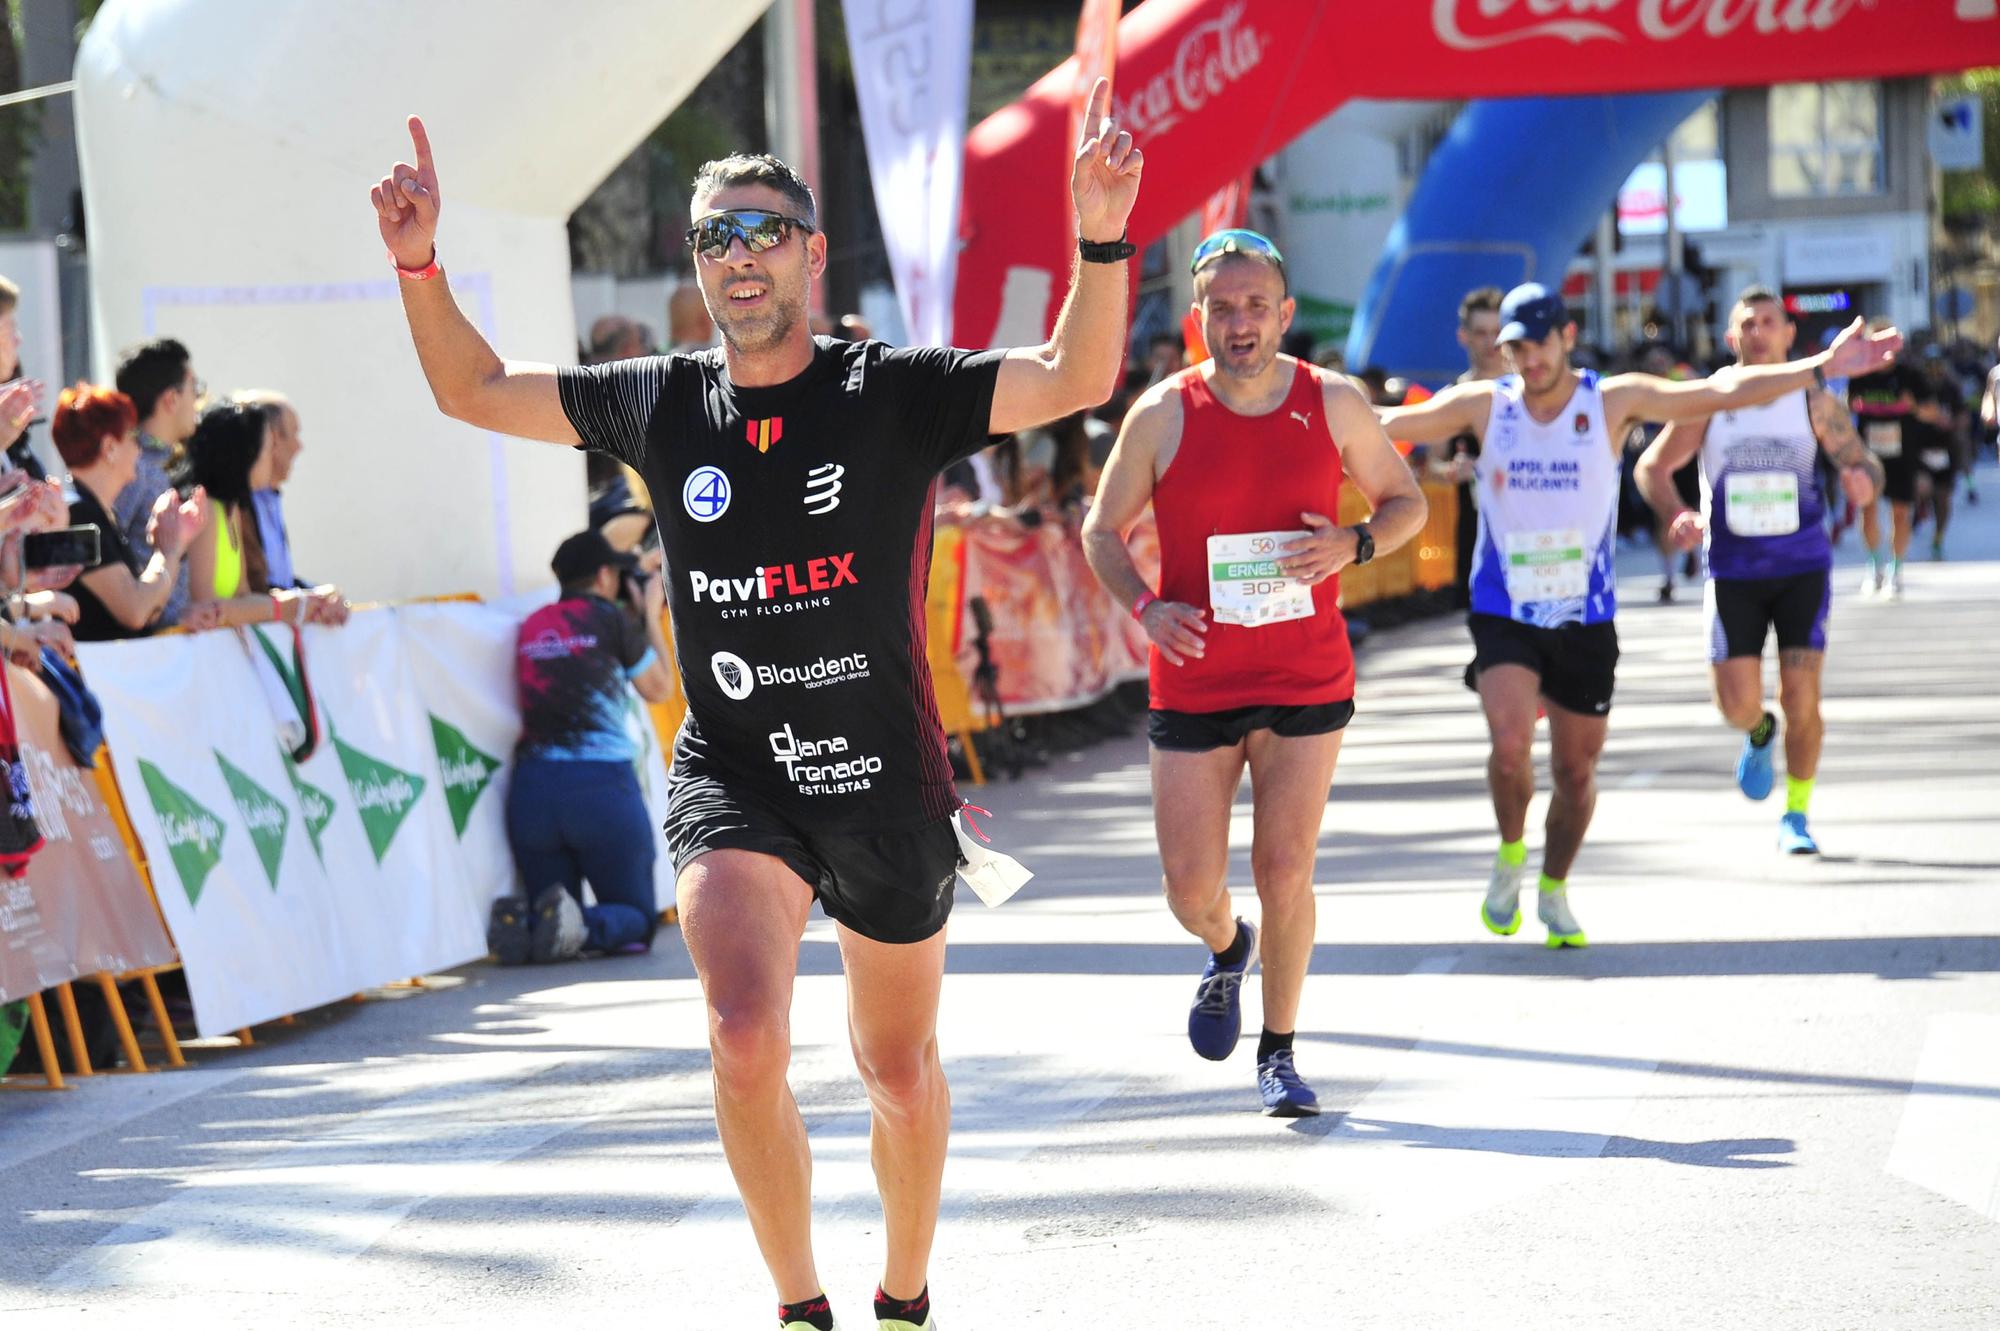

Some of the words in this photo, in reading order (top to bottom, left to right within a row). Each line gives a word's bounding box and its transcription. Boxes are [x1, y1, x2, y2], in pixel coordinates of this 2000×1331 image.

[691, 471, 727, 517] 4
[689, 552, 858, 603] PaviFLEX
[1227, 562, 1279, 577] ERNES
[1242, 581, 1286, 596] 302
[721, 608, 748, 619] GYM
[757, 596, 831, 616] FLOORING
[756, 653, 868, 685] Blaudent
[804, 675, 846, 689] laboratorio
[846, 669, 871, 680] dental
[774, 755, 882, 782] Trenado
[799, 778, 871, 796] ESTILISTAS
